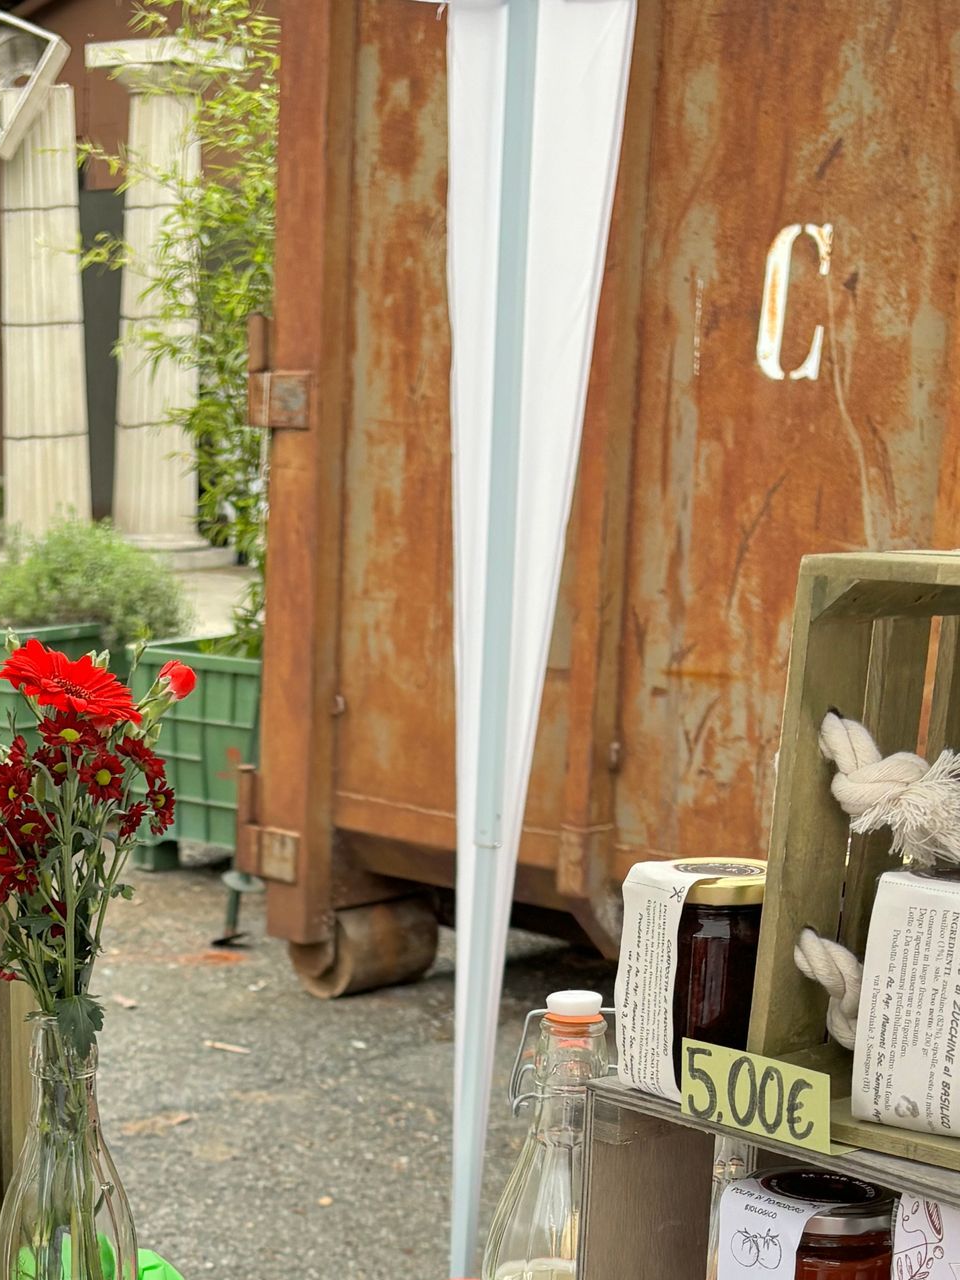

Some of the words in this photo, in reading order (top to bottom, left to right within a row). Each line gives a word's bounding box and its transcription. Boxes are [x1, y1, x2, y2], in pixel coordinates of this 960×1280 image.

[756, 223, 833, 381] C
[906, 906, 917, 927] Lotto
[916, 908, 927, 929] Dopo
[923, 909, 938, 953] Conservare
[938, 909, 950, 939] basilico
[889, 929, 901, 962] Prodotto
[904, 935, 913, 947] Da
[912, 930, 926, 967] l'apertura
[897, 948, 910, 991] consumarsi
[922, 954, 929, 962] in
[874, 975, 882, 986] via
[906, 968, 919, 1008] conservare
[918, 963, 929, 985] luogo
[867, 987, 881, 1034] Parrocchiale
[881, 993, 892, 1010] Agr.
[917, 987, 927, 1010] fresco
[929, 988, 939, 1006] Peso
[888, 992, 906, 1049] preferibilmente
[905, 1009, 913, 1017] in
[879, 1014, 890, 1050] Manenti
[923, 1033, 933, 1048] 200
[946, 999, 960, 1063] ZUCCHINE
[863, 1043, 875, 1077] Sostegno
[943, 1066, 952, 1078] al
[687, 1046, 815, 1140] 5,00€
[873, 1072, 884, 1106] Semplice
[885, 1073, 894, 1089] vedi
[884, 1090, 893, 1111] fondo
[939, 1081, 952, 1130] BASILICO
[731, 1186, 754, 1199] POLPA
[765, 1196, 805, 1215] POMODORO
[744, 1203, 778, 1220] BIOLOGICO
